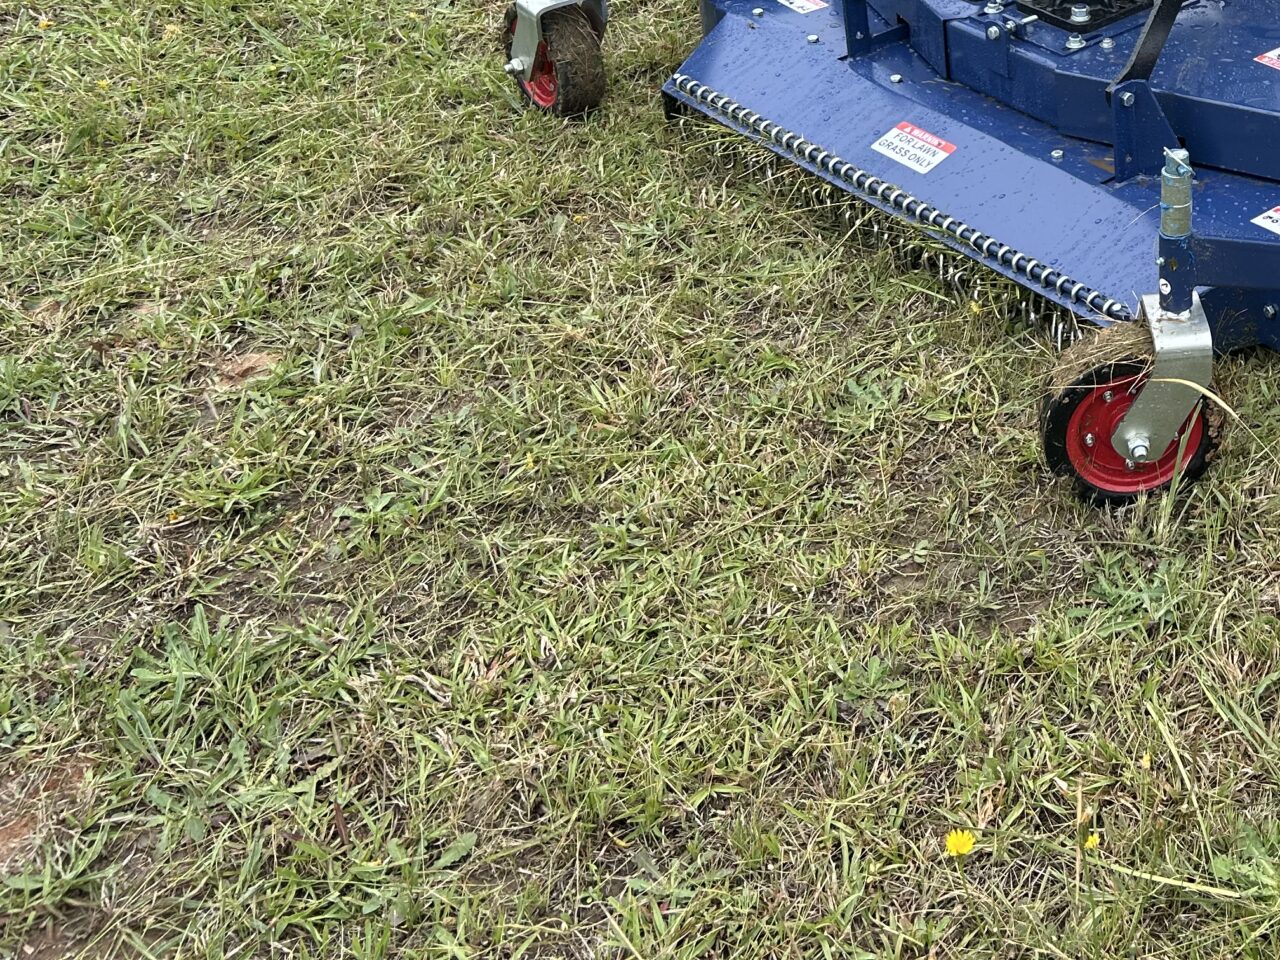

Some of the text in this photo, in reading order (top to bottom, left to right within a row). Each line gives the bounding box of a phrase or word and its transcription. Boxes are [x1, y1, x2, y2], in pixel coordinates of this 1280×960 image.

[878, 138, 934, 168] GRASS ONLY
[893, 132, 939, 158] FOR LAWN
